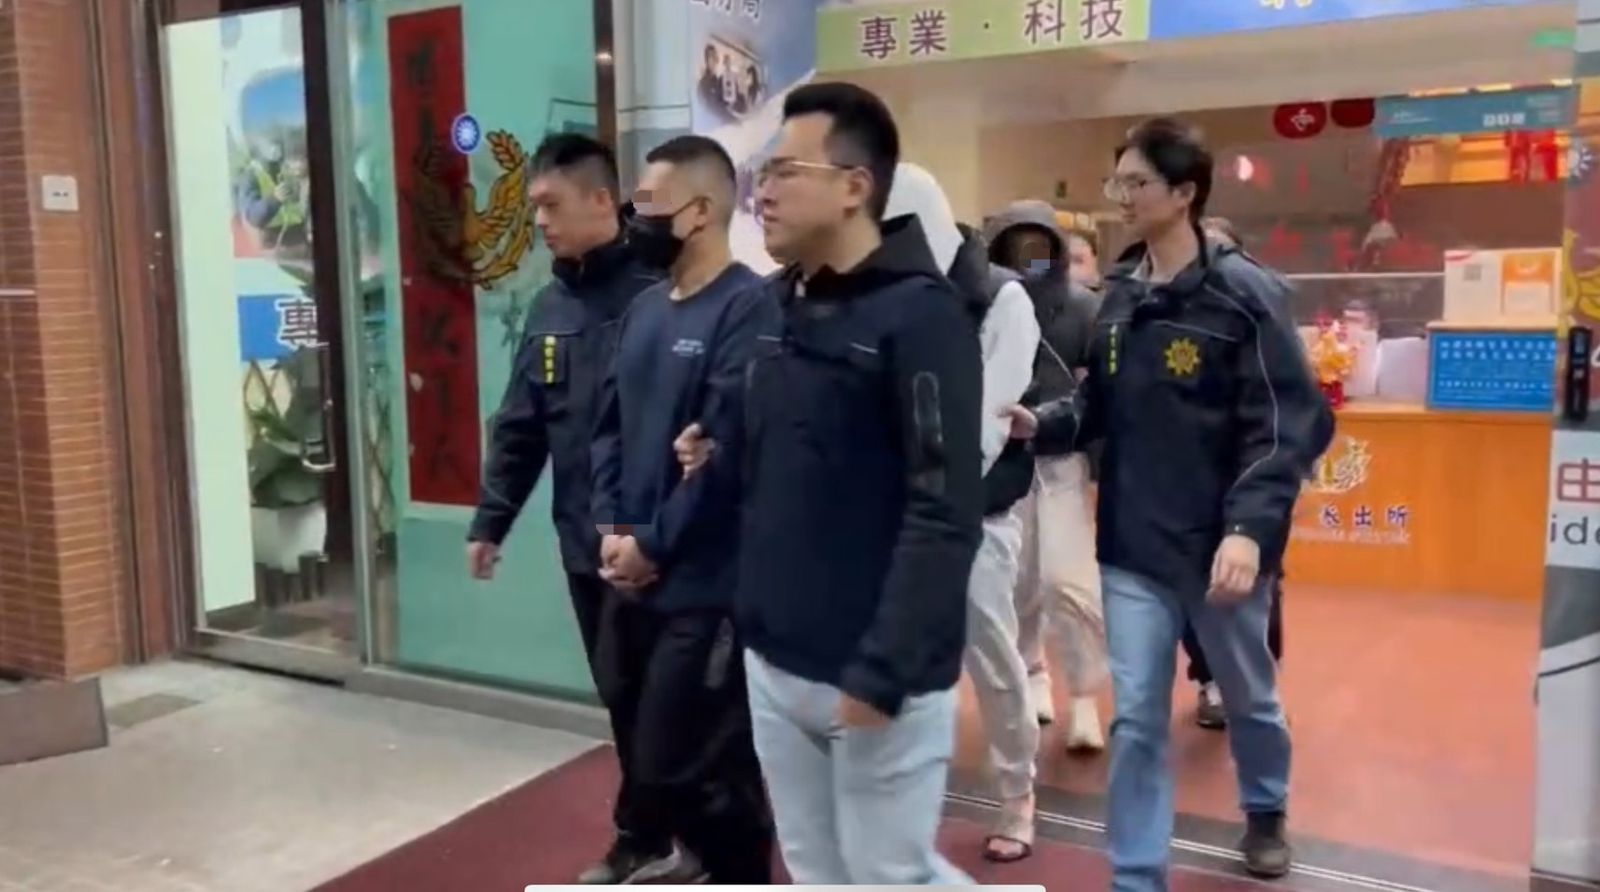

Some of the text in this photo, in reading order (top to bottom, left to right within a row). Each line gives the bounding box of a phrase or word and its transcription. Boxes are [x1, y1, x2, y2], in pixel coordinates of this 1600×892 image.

[860, 9, 947, 59] 專業
[1023, 0, 1123, 45] 科技
[1550, 514, 1600, 545] id
